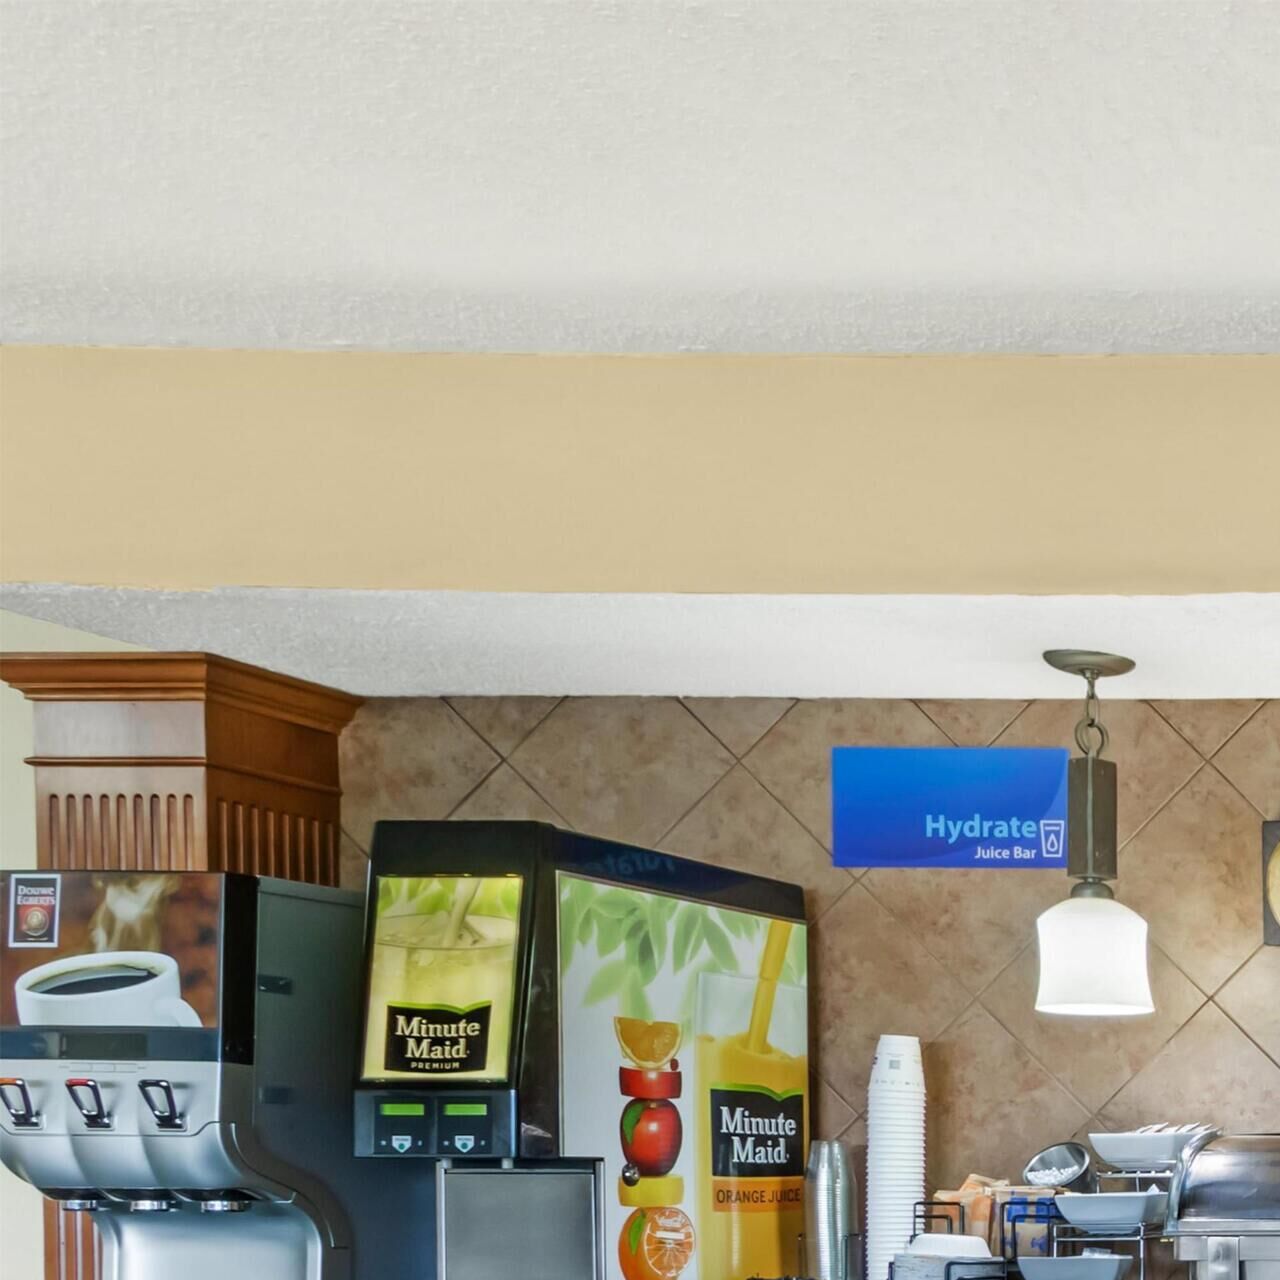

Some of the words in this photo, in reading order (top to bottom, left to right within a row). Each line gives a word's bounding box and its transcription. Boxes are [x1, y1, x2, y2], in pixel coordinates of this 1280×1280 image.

[925, 814, 1037, 844] Hydrate
[974, 846, 1010, 859] Juice
[1013, 846, 1036, 859] Bar
[394, 1014, 481, 1037] Minute
[404, 1038, 468, 1058] Maid
[411, 1061, 460, 1070] PREMIUM
[720, 1106, 797, 1136] Minute
[731, 1136, 788, 1163] Maid
[716, 1188, 766, 1204] ORANGE
[768, 1187, 801, 1204] JUICE
